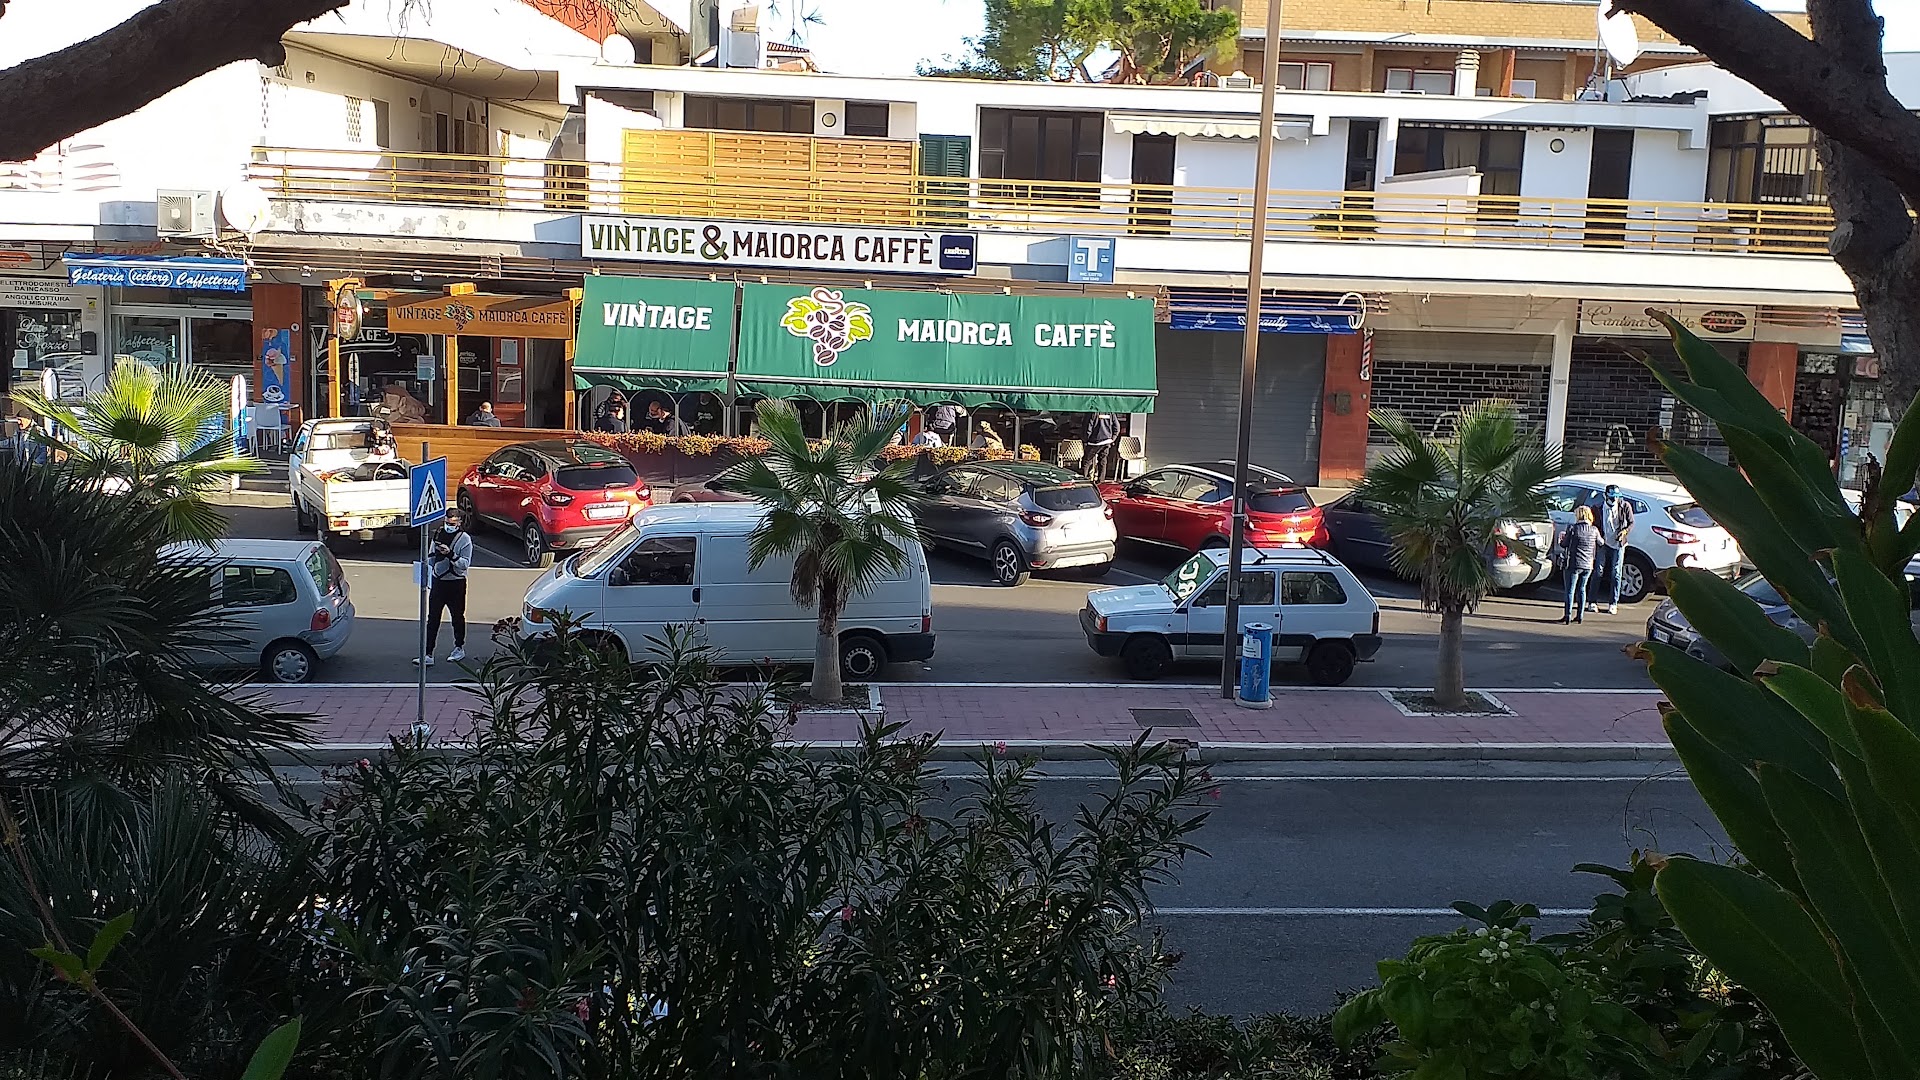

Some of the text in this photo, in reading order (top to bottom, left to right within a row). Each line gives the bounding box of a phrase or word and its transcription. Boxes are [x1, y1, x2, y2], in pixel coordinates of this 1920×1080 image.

[700, 225, 729, 260] &
[733, 231, 845, 261] MAIORCA
[855, 233, 933, 264] CAFFÈ
[1076, 238, 1111, 272] T
[71, 267, 240, 289] Gelateria iceberg Caffetteria
[479, 310, 528, 323] MAIORCA
[897, 318, 1116, 348] MAIORCA CAFFÈ
